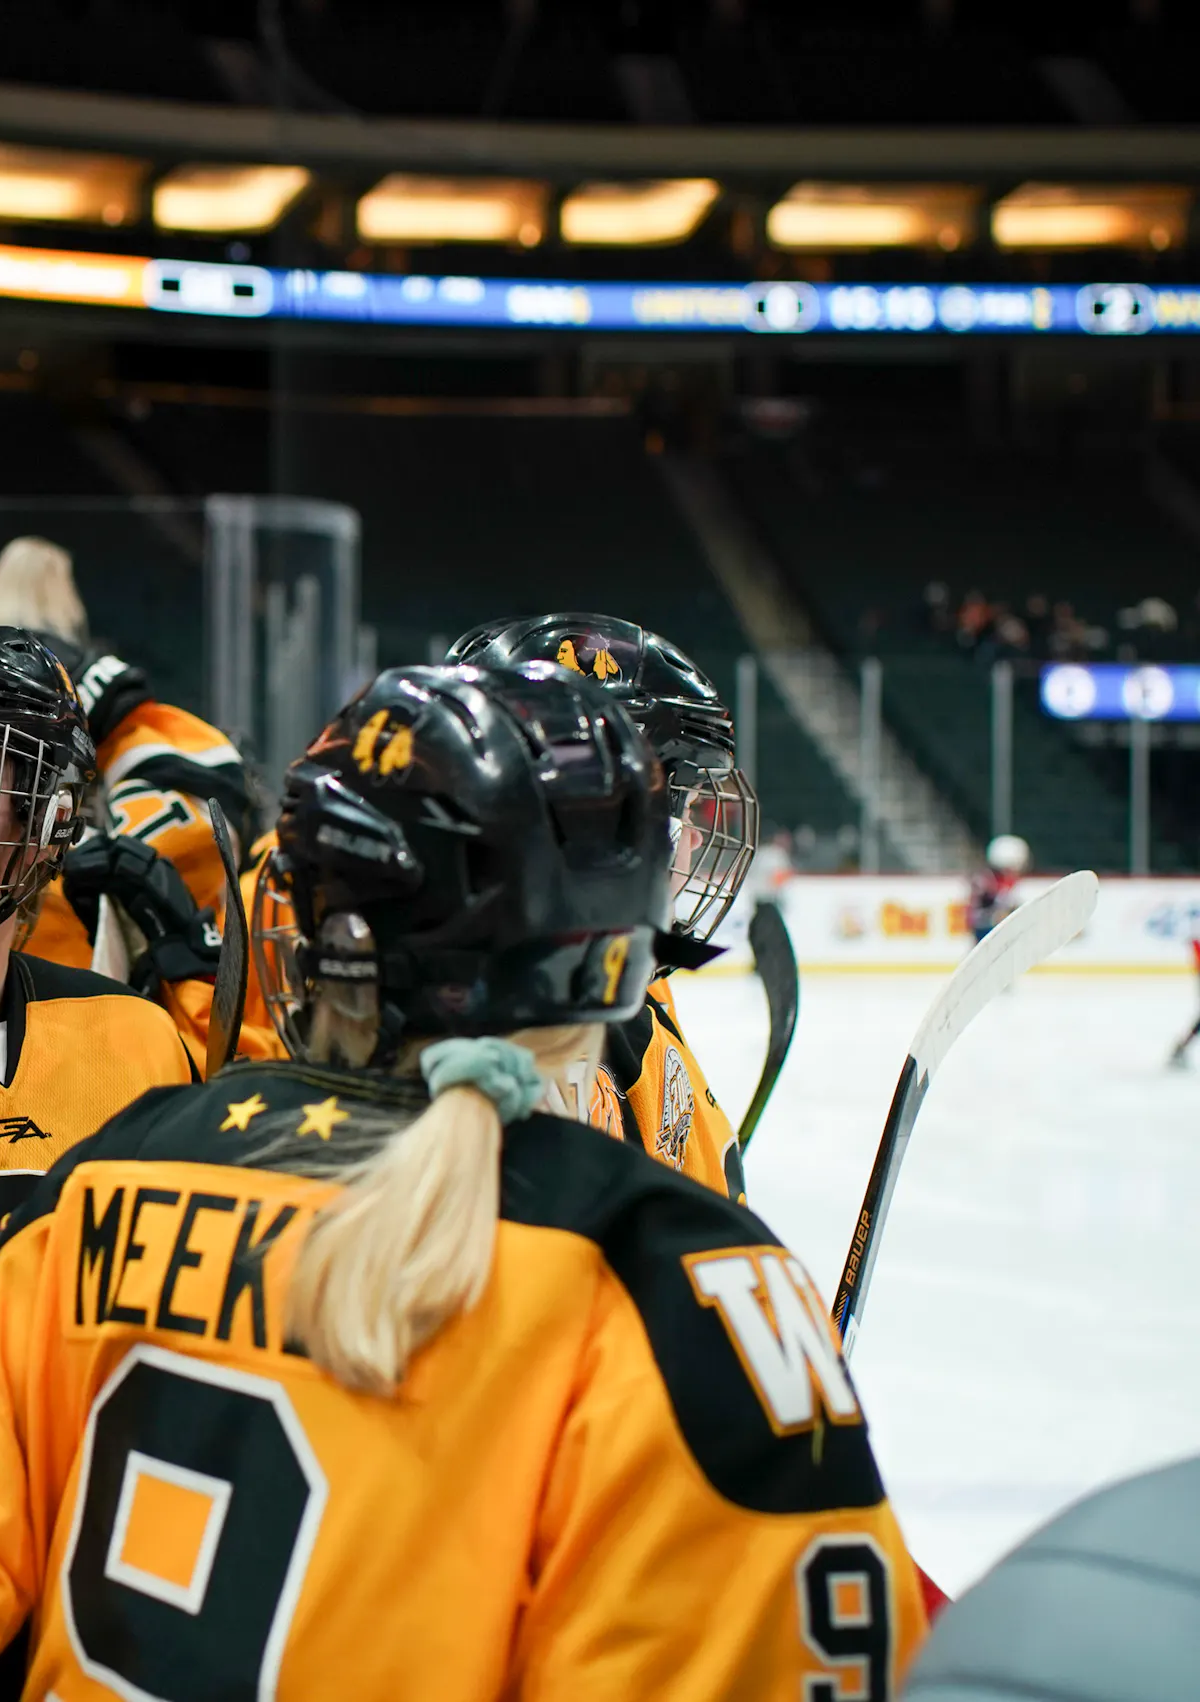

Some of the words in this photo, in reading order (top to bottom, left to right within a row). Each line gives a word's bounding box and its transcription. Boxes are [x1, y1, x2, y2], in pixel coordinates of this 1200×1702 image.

[603, 935, 630, 1005] 9
[74, 1186, 313, 1360] MEEK
[845, 1209, 870, 1287] BAUER
[679, 1245, 863, 1437] W
[795, 1533, 894, 1702] 9
